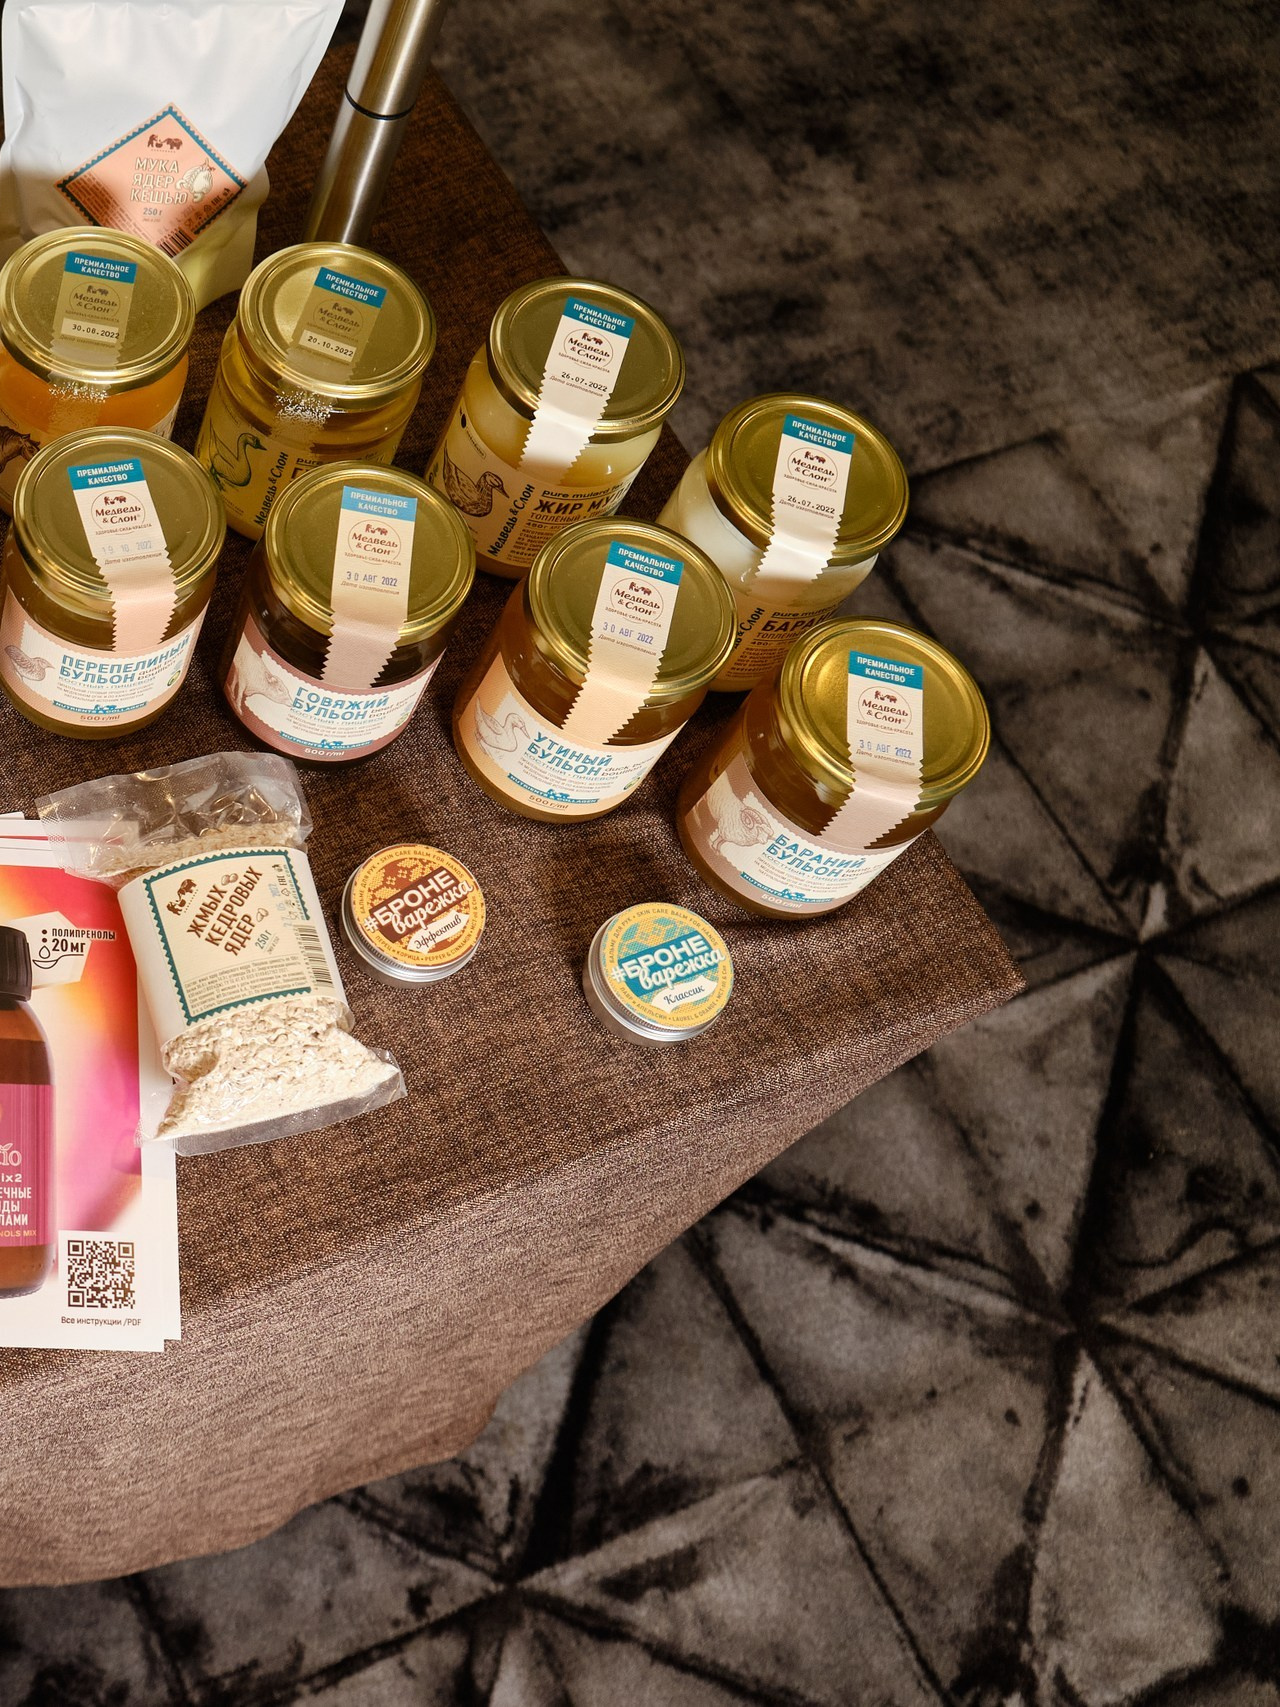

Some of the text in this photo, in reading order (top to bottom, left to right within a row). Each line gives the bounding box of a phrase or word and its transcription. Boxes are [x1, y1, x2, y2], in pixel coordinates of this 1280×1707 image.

[135, 157, 179, 173] МУКА
[132, 174, 174, 189] ЯДЕР
[130, 188, 188, 205] КЕШЬЮ
[74, 257, 129, 273] ПРЕМИАЛЬНОЕ
[81, 267, 120, 278] КАЧЕСТВО
[326, 274, 379, 297] ПРЕМИАЛЬНОЕ
[331, 284, 368, 300] КАЧЕСТВО
[574, 303, 626, 327] ПРЕМИАЛЬНОЕ
[579, 313, 616, 331] КАЧЕСТВО
[308, 336, 353, 357] 20.10.2022
[561, 371, 608, 393] 26.07.2022
[792, 421, 846, 443] ПРЕМИАЛЬНОЕ
[799, 431, 837, 447] КАЧЕСТВО
[77, 463, 134, 477] ПРЕМИАЛЬНОЕ
[88, 474, 128, 485] КАЧЕСТВО
[351, 492, 408, 508] ПРЕМИАЛЬНОЕ
[358, 503, 398, 515] КАЧЕСТВО
[535, 500, 584, 515] ЖИР
[788, 495, 835, 514] 26.07.2022
[352, 532, 398, 548] Медведь
[364, 544, 391, 556] Слон
[618, 548, 675, 571] ПРЕМИАЛЬНОЕ
[625, 560, 664, 578] КАЧЕСТВО
[363, 574, 377, 583] АВГ
[381, 576, 398, 587] 2022
[61, 633, 190, 674] ПЕРЕПЕЛИНЫЙ
[60, 667, 135, 684] БУЛЬОН
[857, 657, 915, 676] ПРЕМИАЛЬНОЕ
[865, 669, 905, 683] КАЧЕСТВО
[296, 686, 390, 710] ГОВЯЖИЙ
[292, 698, 370, 721] БУЛЬОН
[534, 732, 614, 767] УТИНЫЙ
[527, 743, 604, 776] БУЛЬОН
[775, 834, 867, 869] БАРАНИЙ
[380, 854, 394, 863] SKIN
[433, 855, 444, 863] FOR
[446, 863, 463, 878] HANDS
[766, 844, 845, 879] БУЛЬОН
[186, 884, 229, 939] ЖМЫХ
[204, 866, 263, 947] КЕДРОВЫХ
[363, 870, 455, 934] #БРОНЕ
[392, 880, 474, 934] варежка
[52, 929, 116, 939] ПОЛИПРЕНОЛЫ
[224, 914, 256, 956] ЯДЕР
[414, 915, 462, 949] Эффектив
[52, 938, 86, 952] 20 мг
[612, 935, 709, 982] #БРОНЕ
[638, 950, 726, 990] варежка
[664, 985, 705, 1004] Классик
[61, 1316, 75, 1324] Все
[77, 1318, 121, 1326] инструкции
